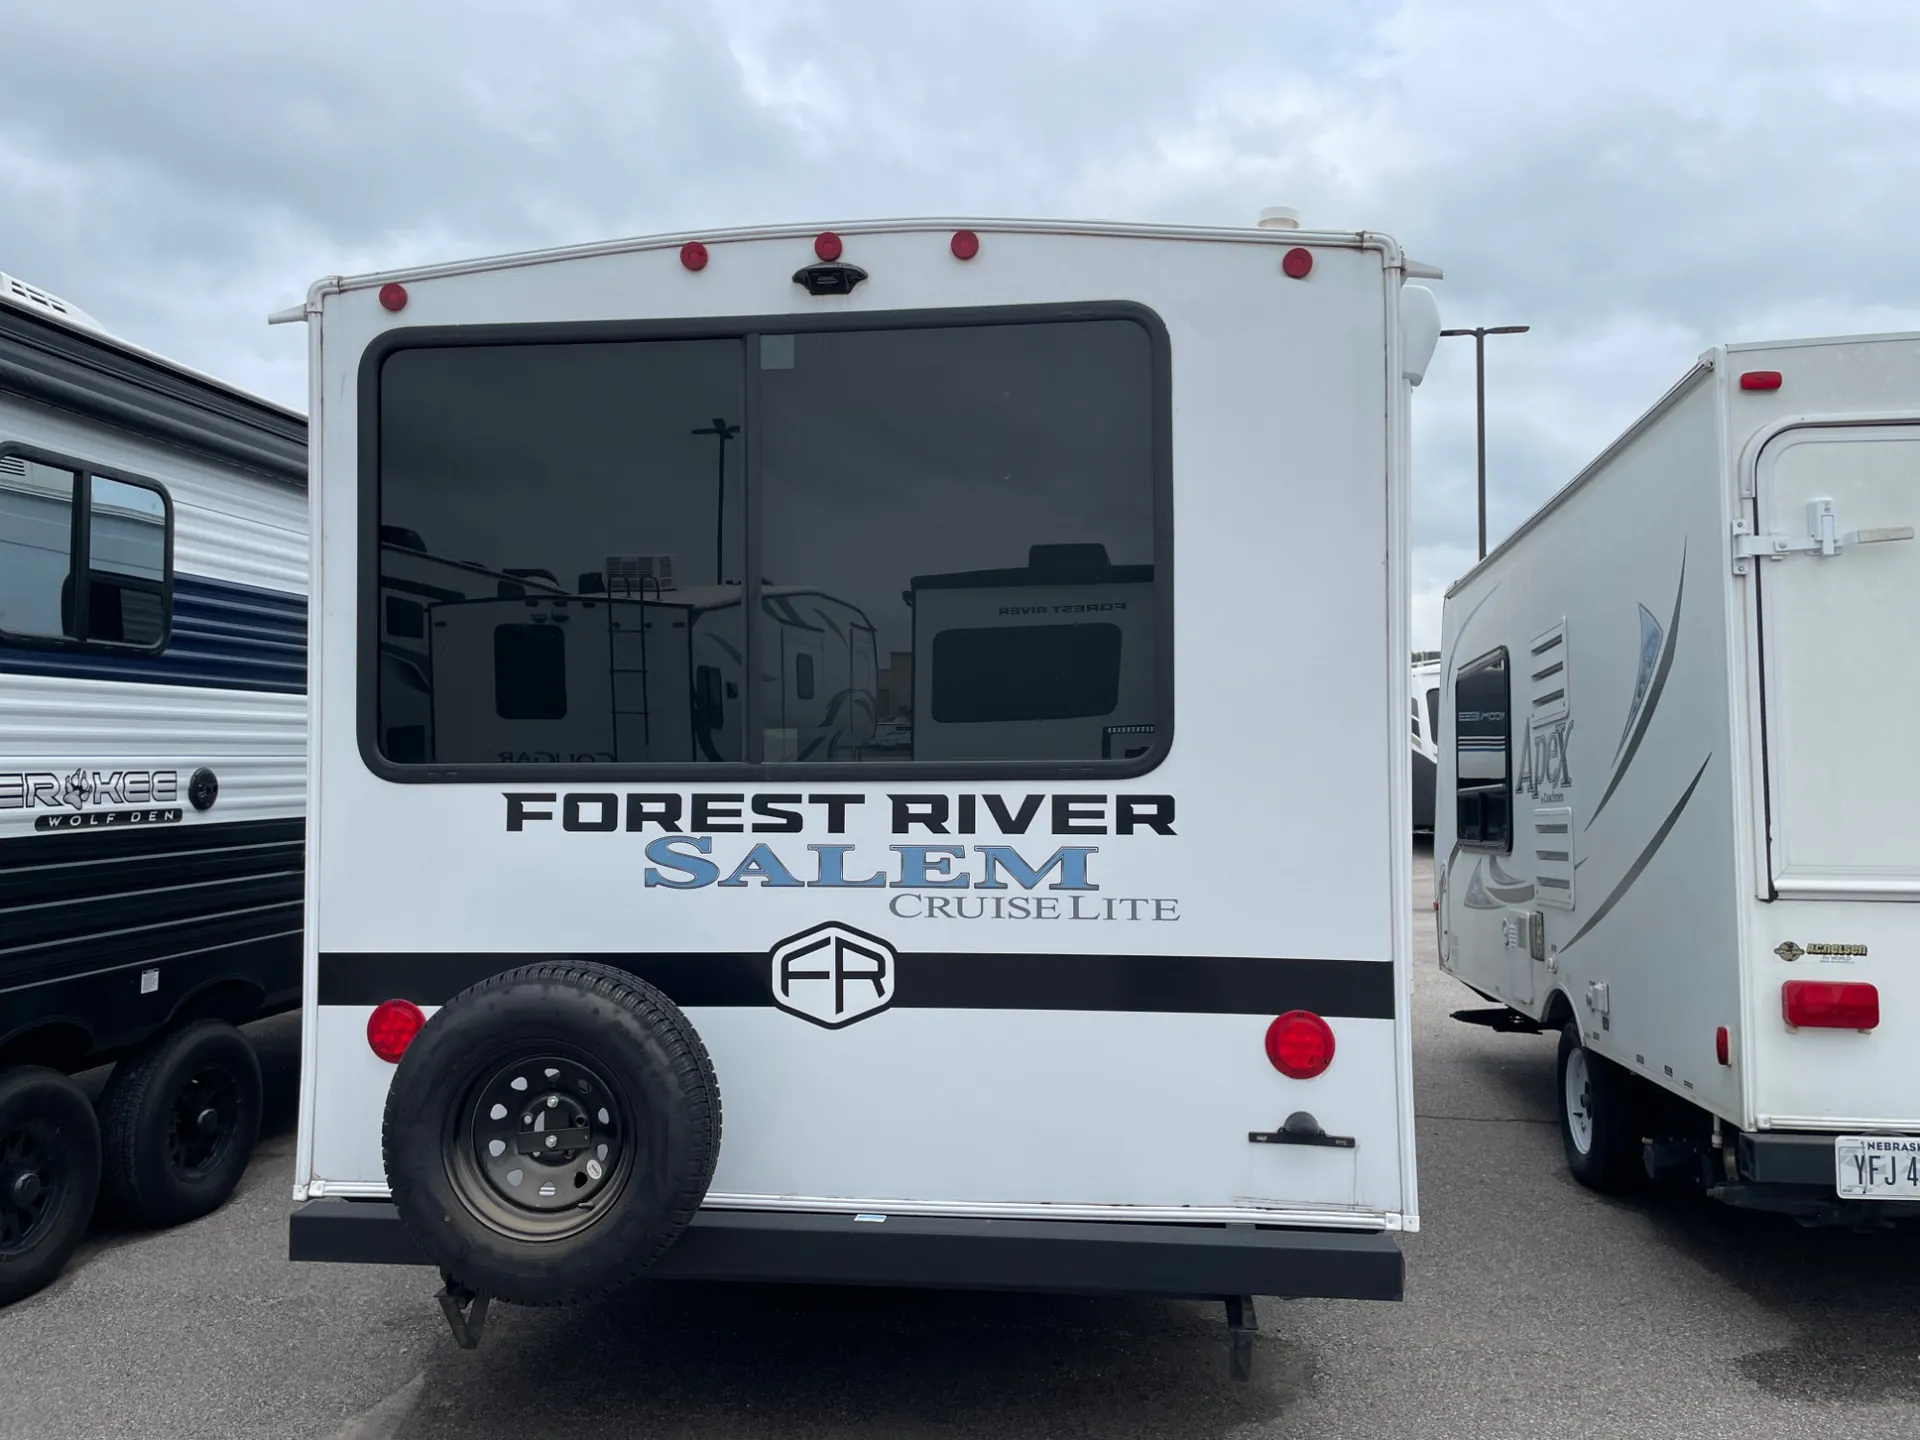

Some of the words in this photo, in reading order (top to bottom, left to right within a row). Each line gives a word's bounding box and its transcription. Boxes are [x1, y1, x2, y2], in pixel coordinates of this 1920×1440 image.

[48, 813, 116, 827] WOLF
[131, 810, 174, 823] DEN
[502, 793, 866, 833] FOREST
[887, 794, 1178, 835] RIVER
[644, 835, 1100, 891] SALEM
[1854, 1154, 1897, 1186] YFJ
[1906, 1156, 1919, 1187] 4
